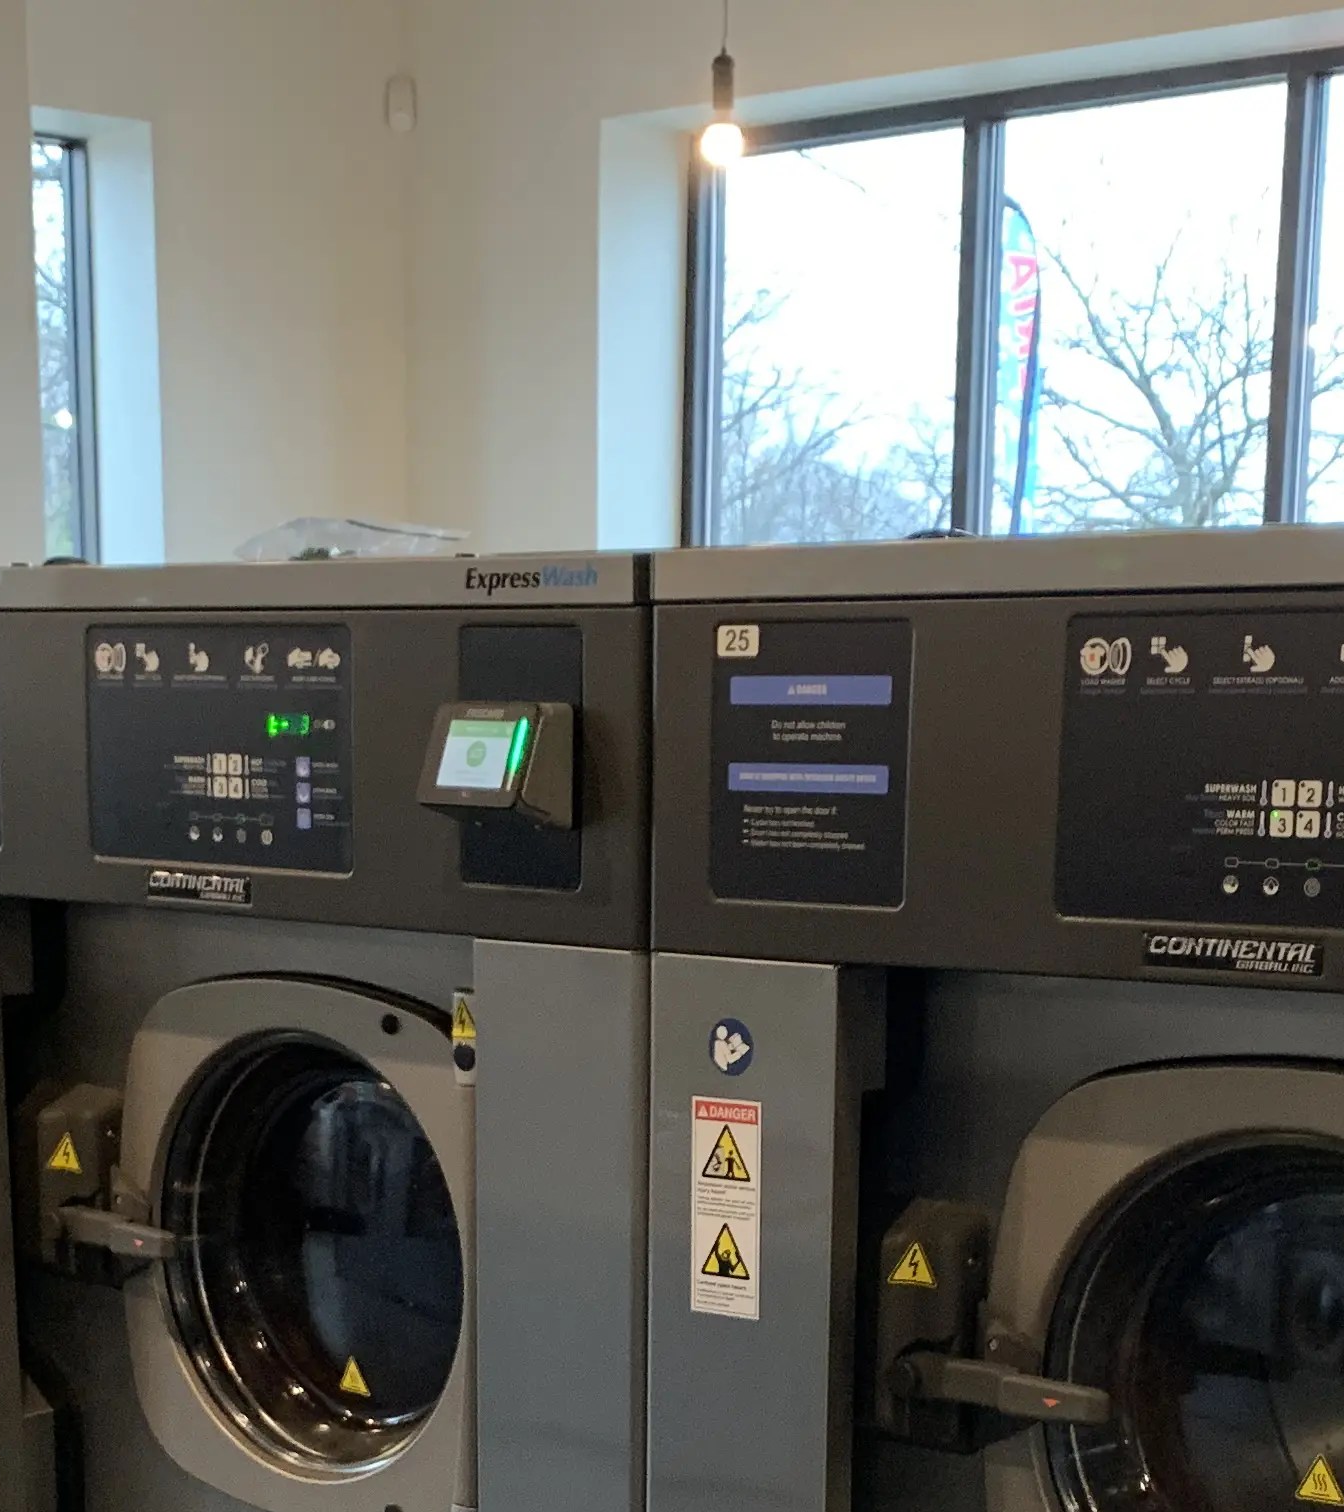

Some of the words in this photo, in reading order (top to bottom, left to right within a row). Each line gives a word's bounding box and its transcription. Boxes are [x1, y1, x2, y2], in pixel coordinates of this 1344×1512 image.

[465, 561, 598, 596] ExpressWash
[725, 629, 749, 652] 25
[1205, 783, 1257, 794] SUPERWASH
[1281, 788, 1287, 802] 1
[1305, 787, 1315, 803] 2
[1226, 809, 1255, 819] WARM
[1278, 818, 1287, 834] 3
[1303, 818, 1313, 834] 4
[1149, 935, 1316, 964] CONTINENTAL
[709, 1105, 757, 1123] DANGER
